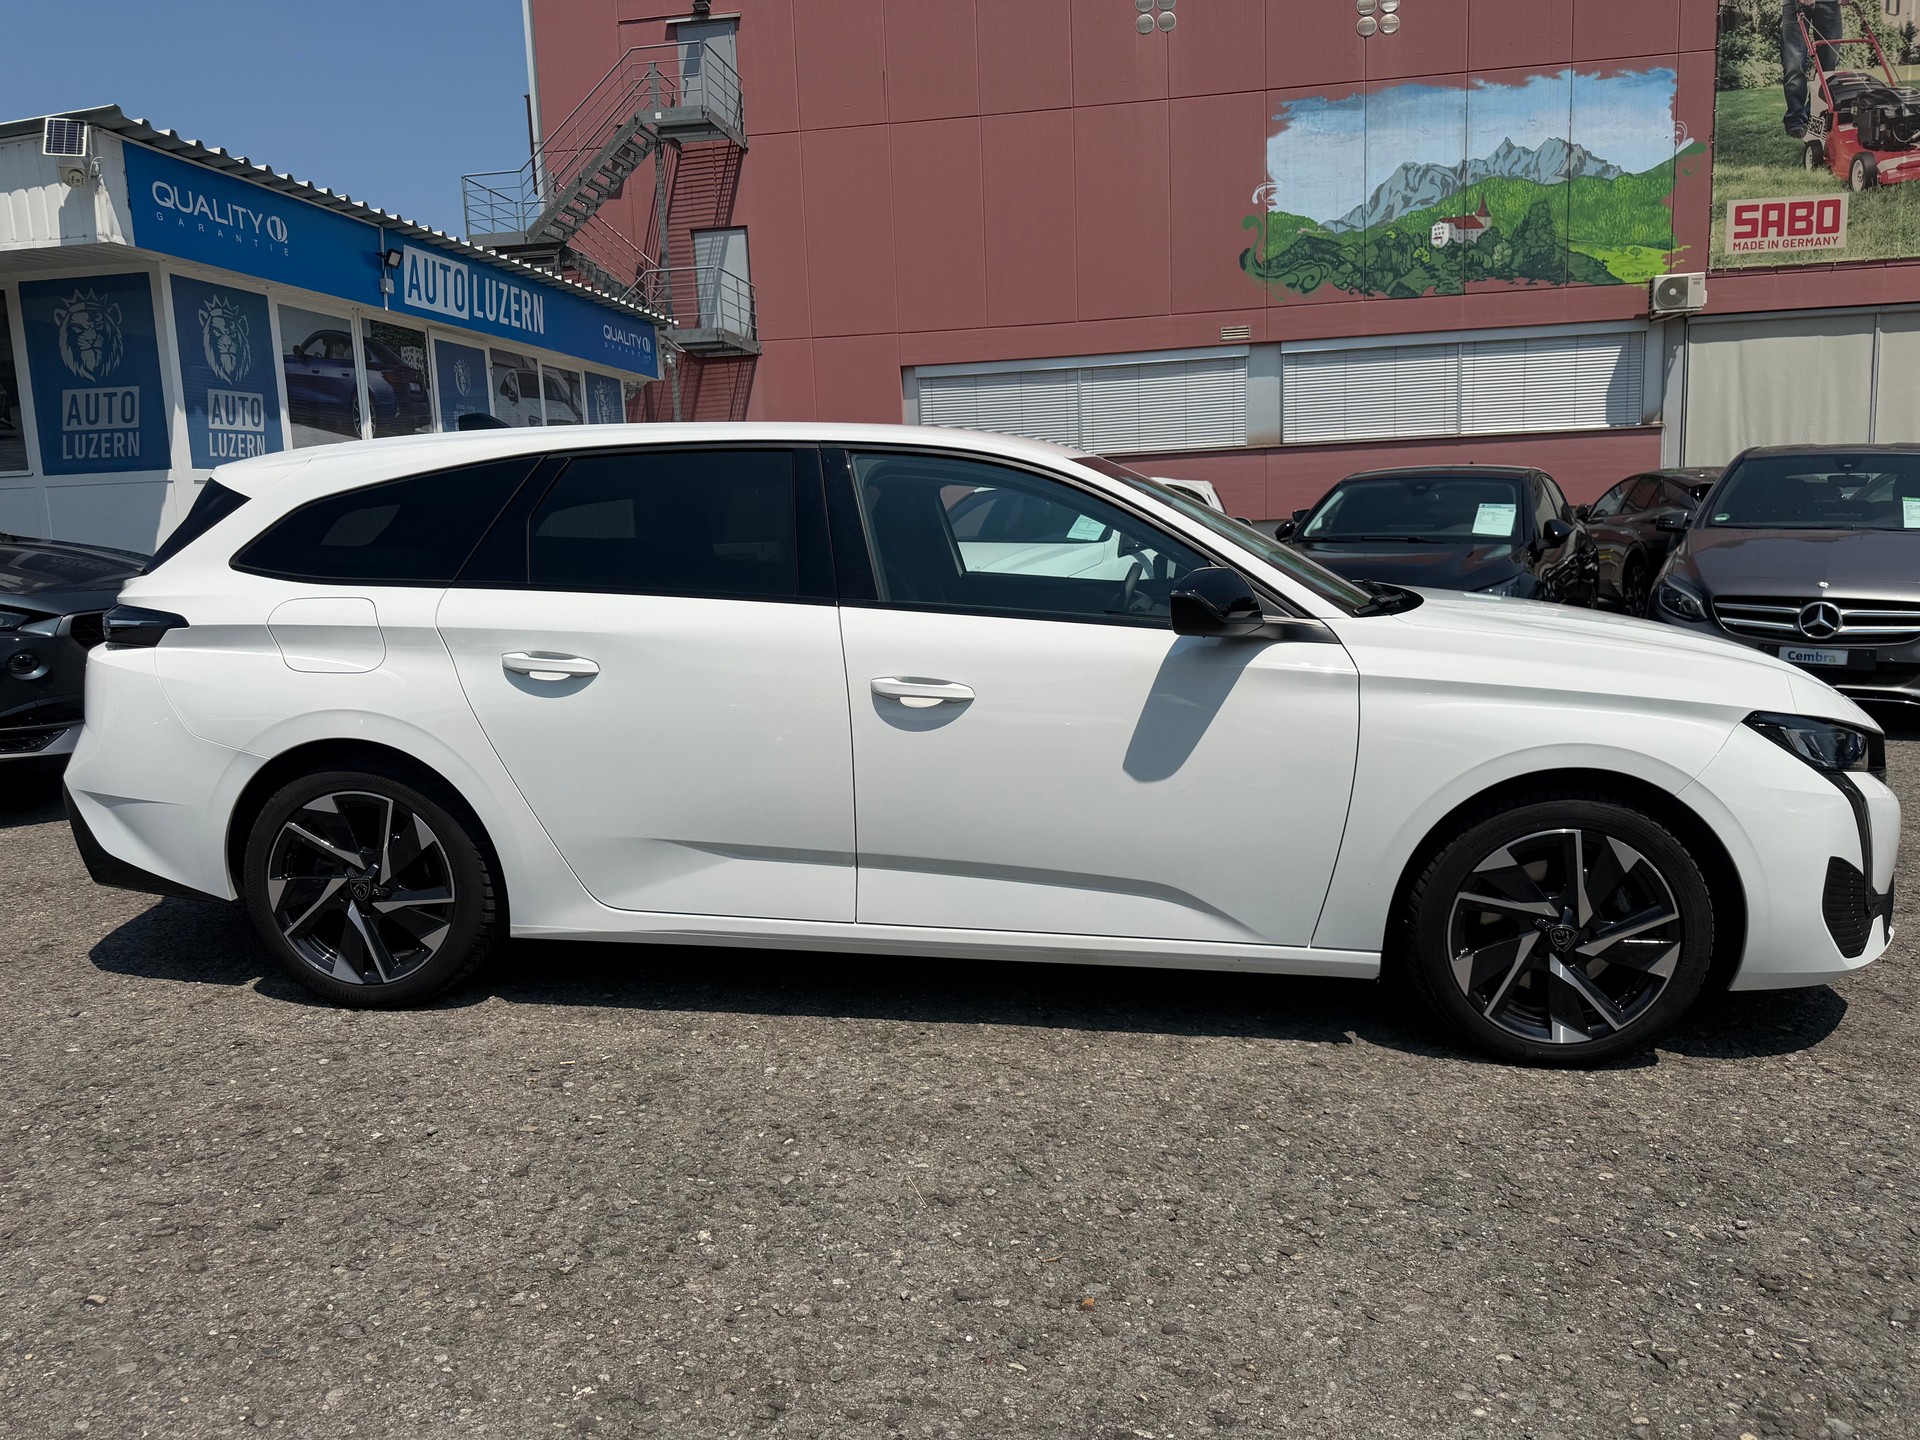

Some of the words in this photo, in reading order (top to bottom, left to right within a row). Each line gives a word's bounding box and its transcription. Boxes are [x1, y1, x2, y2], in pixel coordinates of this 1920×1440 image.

[152, 180, 263, 235] QUALITY
[1733, 199, 1842, 240] SABO
[156, 211, 289, 257] GARANTIE
[1732, 240, 1765, 251] MADE
[1767, 239, 1779, 249] IN
[1782, 236, 1839, 248] GERMANY
[407, 253, 466, 313] AUTO
[472, 273, 545, 335] LUZERN
[603, 324, 642, 349] QUALITY
[65, 390, 137, 427] AUTO
[211, 394, 263, 428] AUTO
[62, 431, 140, 460] LUZERN
[208, 432, 266, 458] LUZERN
[1787, 650, 1837, 663] Cembra
